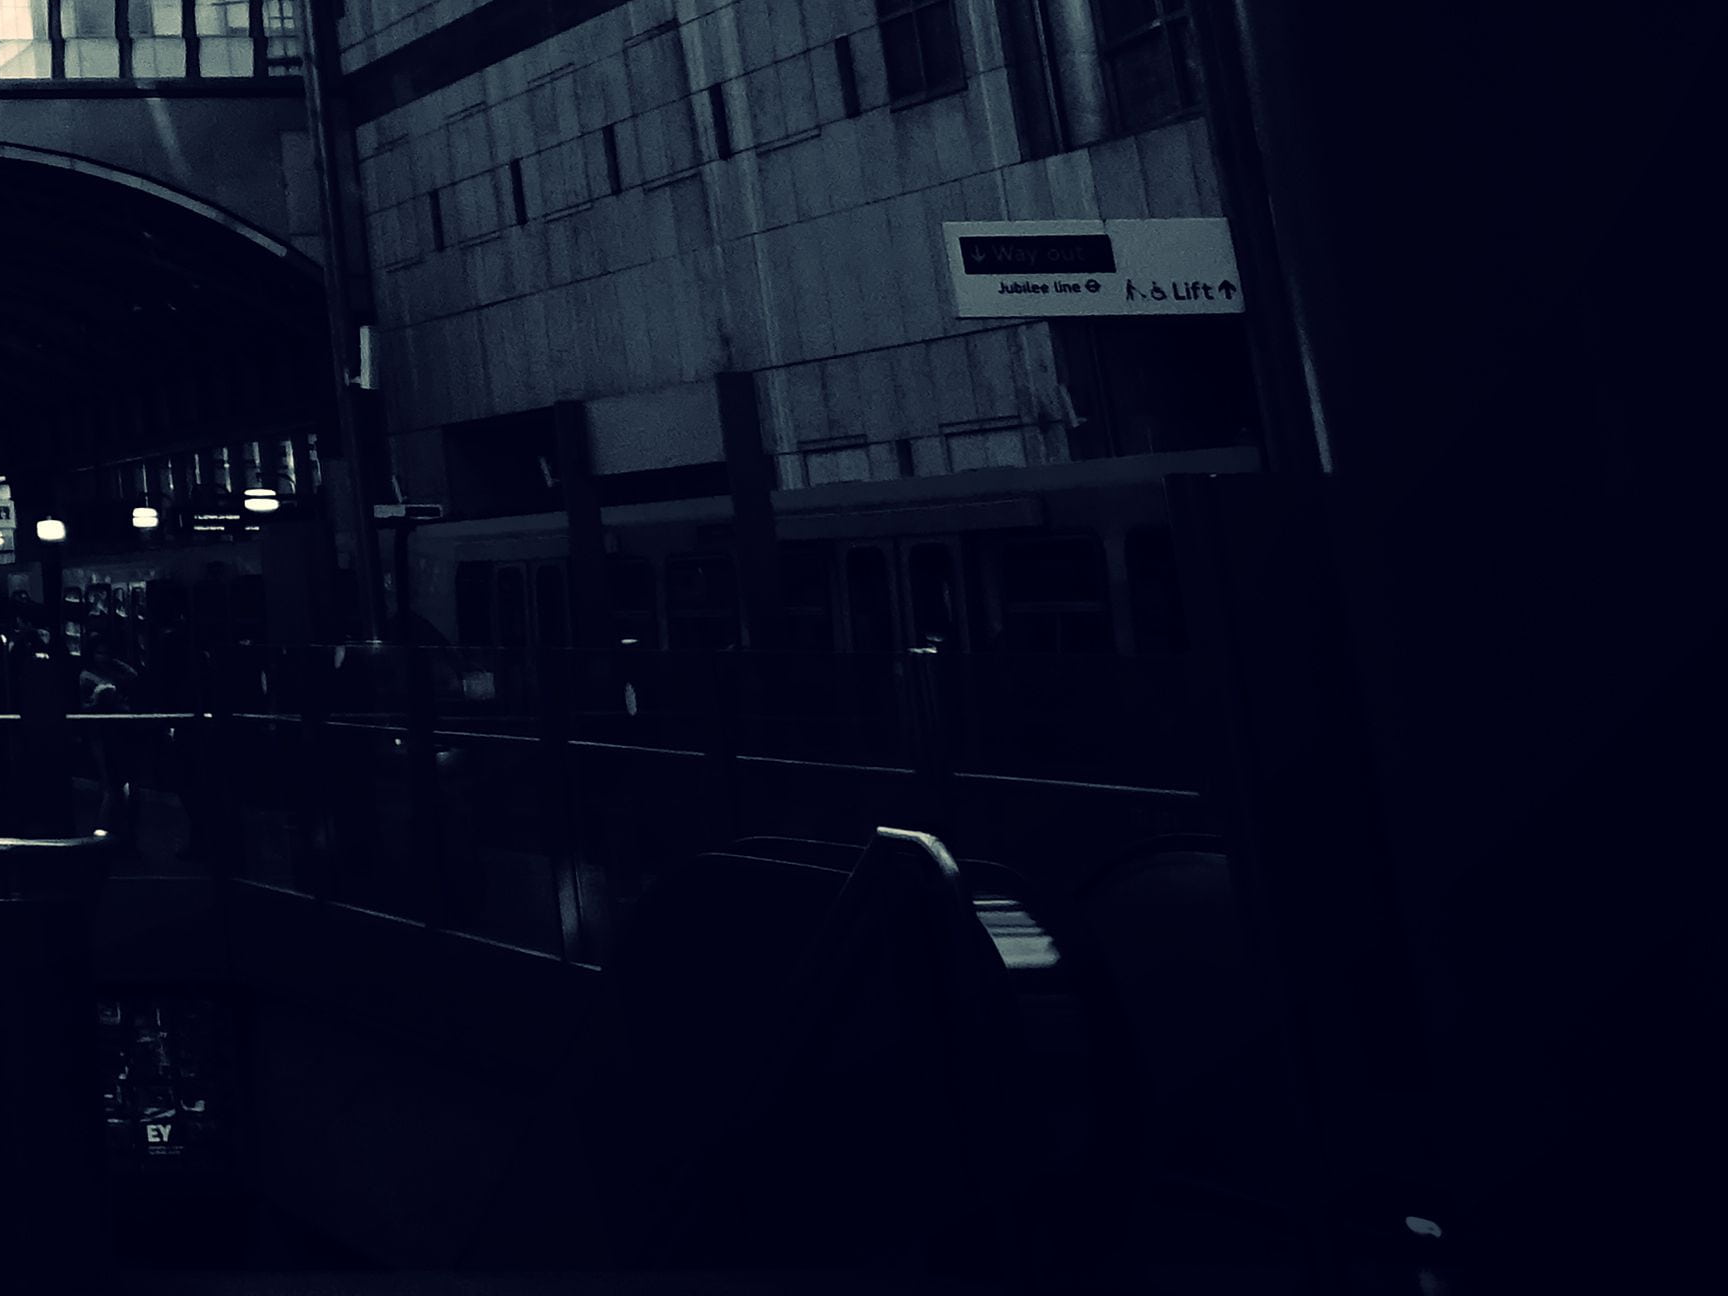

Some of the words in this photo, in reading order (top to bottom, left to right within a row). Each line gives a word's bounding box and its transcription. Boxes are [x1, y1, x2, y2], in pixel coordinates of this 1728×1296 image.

[994, 243, 1039, 266] Way
[1048, 245, 1087, 262] out
[998, 281, 1049, 294] Jubilee
[1054, 281, 1081, 293] line
[1172, 281, 1214, 300] Lift
[146, 1123, 172, 1143] EY
